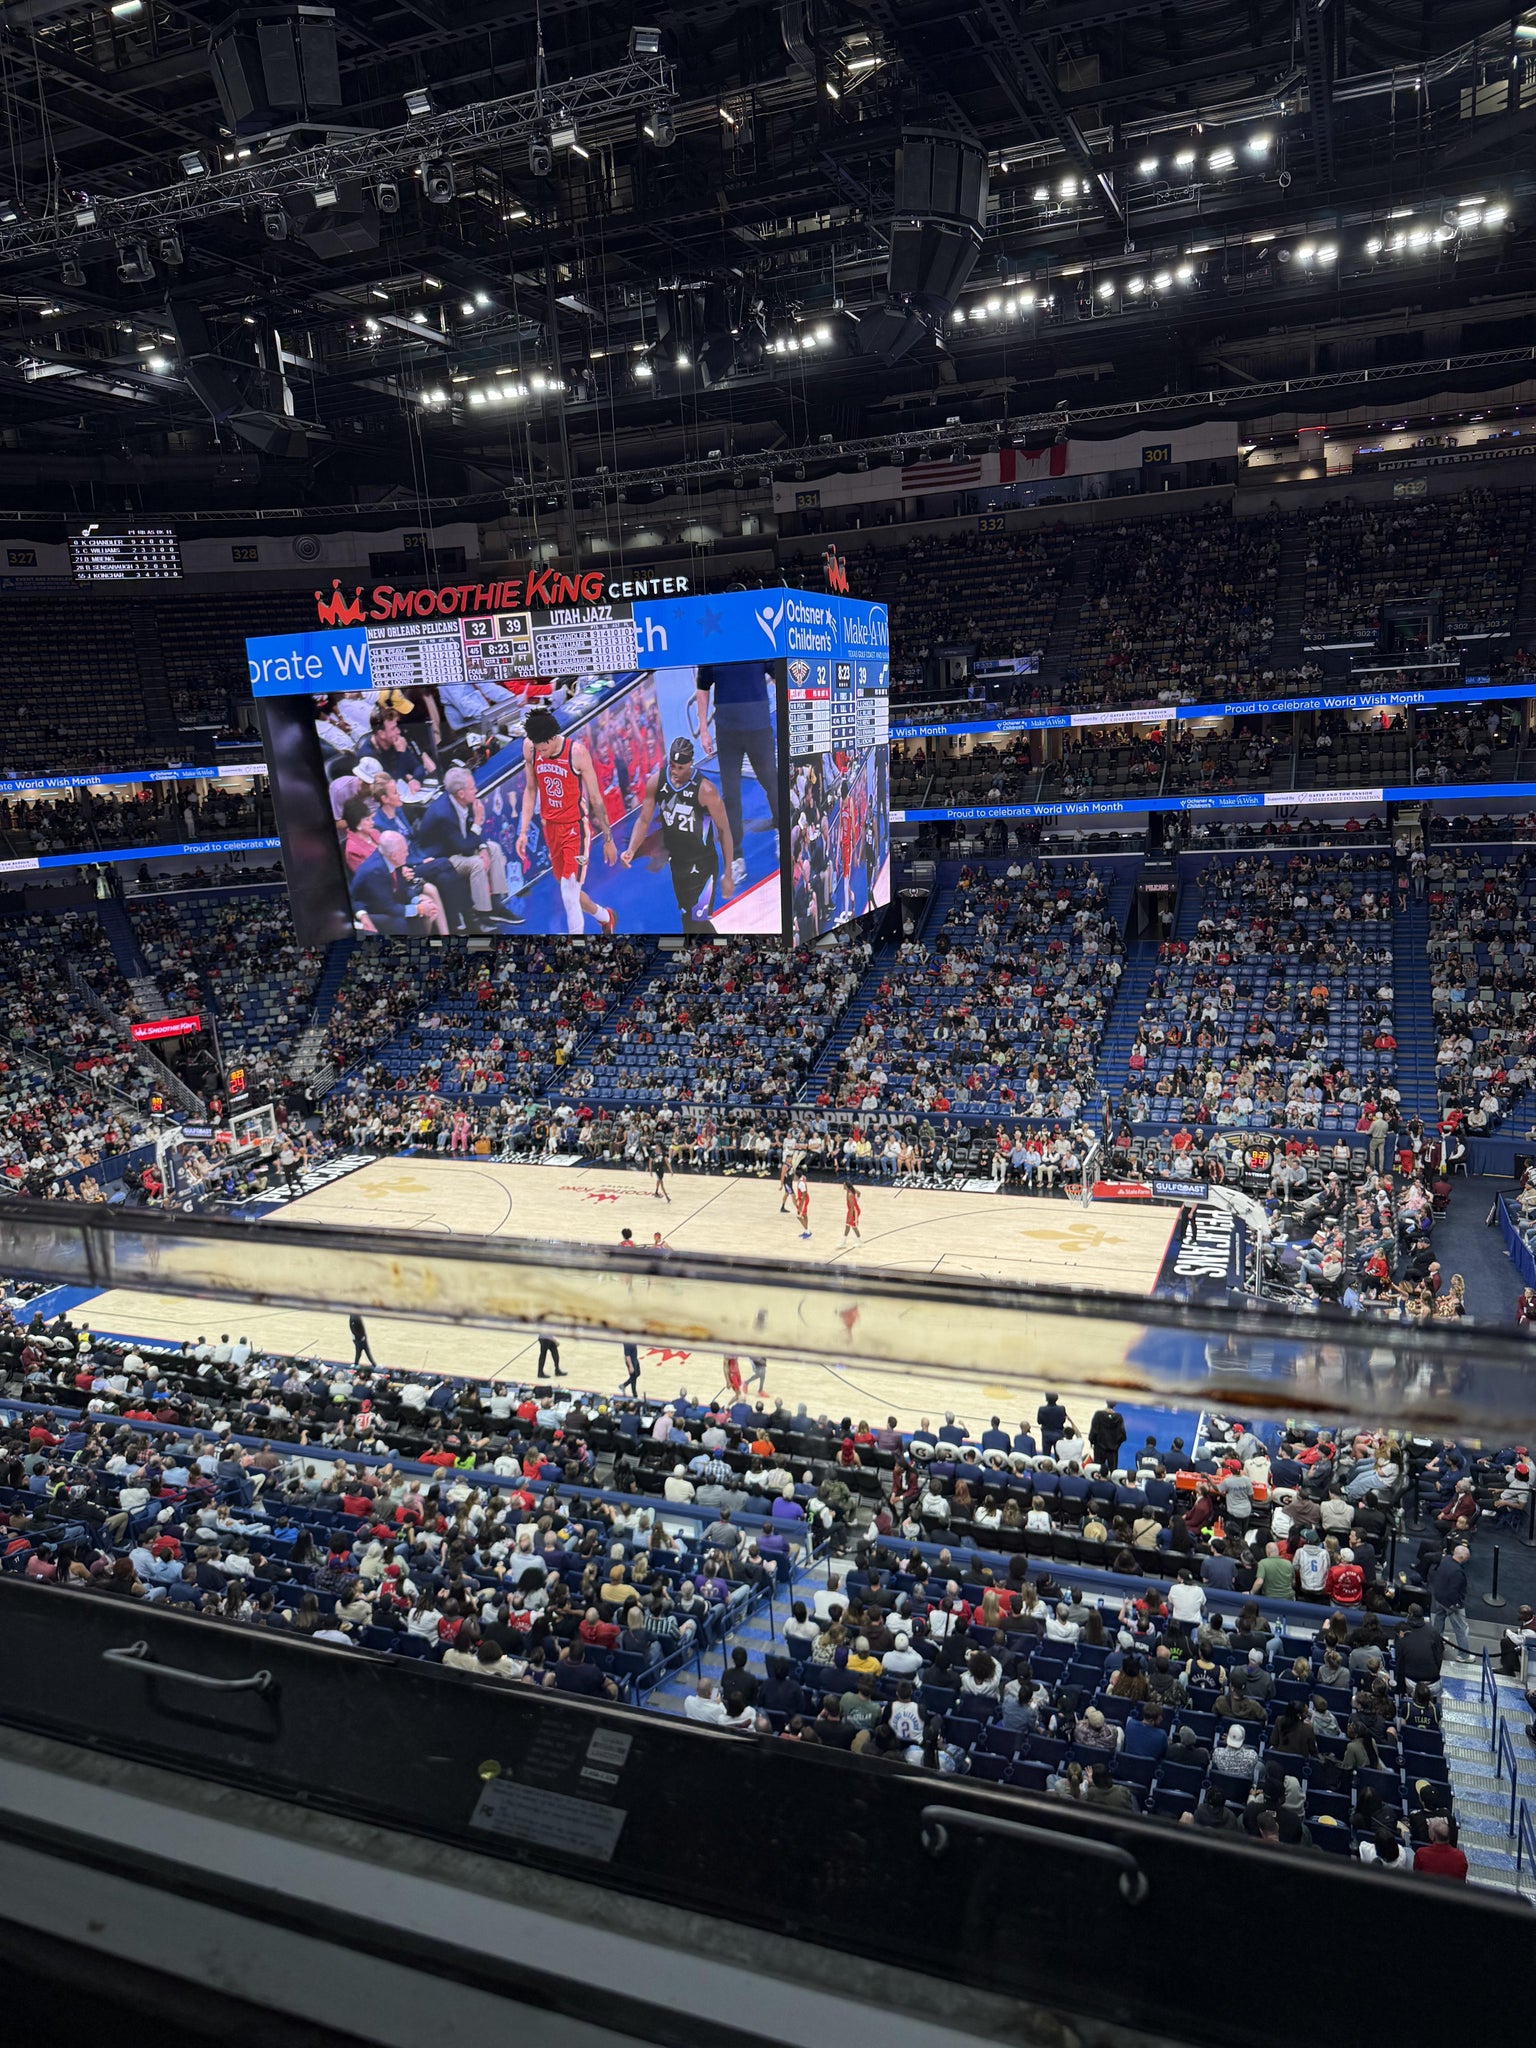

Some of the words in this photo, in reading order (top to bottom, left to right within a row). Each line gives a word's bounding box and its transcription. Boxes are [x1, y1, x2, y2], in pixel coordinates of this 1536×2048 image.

[1144, 450, 1168, 462] 301
[798, 494, 819, 506] 331
[979, 518, 1004, 532] 332
[405, 536, 426, 548] 329
[9, 552, 34, 564] 327
[234, 549, 257, 559] 328
[633, 570, 654, 580] 330
[370, 580, 521, 620] SMOOTHIE
[608, 576, 689, 599] CENTER
[550, 608, 580, 625] UTAH
[583, 606, 613, 622] JAZZ
[787, 599, 824, 625] Ochsner
[368, 628, 385, 639] NEW
[387, 625, 421, 637] ORLEANS
[422, 622, 458, 634] PELICANS
[472, 623, 487, 635] 32
[506, 620, 520, 632] 39
[788, 627, 832, 652] Children's
[488, 644, 509, 655] 8:23
[817, 666, 826, 684] 32
[838, 665, 850, 680] 8:23
[859, 667, 866, 684] 39
[1225, 704, 1255, 714] Proud
[1258, 704, 1269, 712] to
[1272, 700, 1320, 711] celebrate
[1323, 697, 1356, 707] World
[1360, 695, 1386, 705] Wish
[1390, 693, 1424, 703] Month
[896, 727, 917, 736] Wish
[920, 726, 946, 735] Month
[537, 763, 568, 778] CRESCENT
[15, 780, 44, 789] World
[46, 778, 70, 787] Wish
[72, 776, 101, 785] Month
[544, 777, 563, 798] 23
[549, 798, 562, 808] CITY
[948, 810, 973, 818] Proud
[988, 807, 1031, 817] celebrate
[1034, 805, 1062, 814] World
[1065, 804, 1089, 813] Wish
[1092, 803, 1123, 812] Month
[1275, 805, 1298, 818] 102
[678, 815, 694, 832] 21
[183, 844, 209, 854] Proud
[212, 843, 220, 851] to
[223, 840, 263, 850] celebrate
[265, 839, 280, 848] Wo
[229, 851, 246, 862] 121
[148, 1024, 180, 1034] SMOOTHIE
[230, 1079, 245, 1094] 24
[1252, 1151, 1269, 1160] 8:23
[1251, 1159, 1265, 1168] 24
[1310, 1560, 1317, 1572] 6
[902, 1722, 910, 1738] 2
